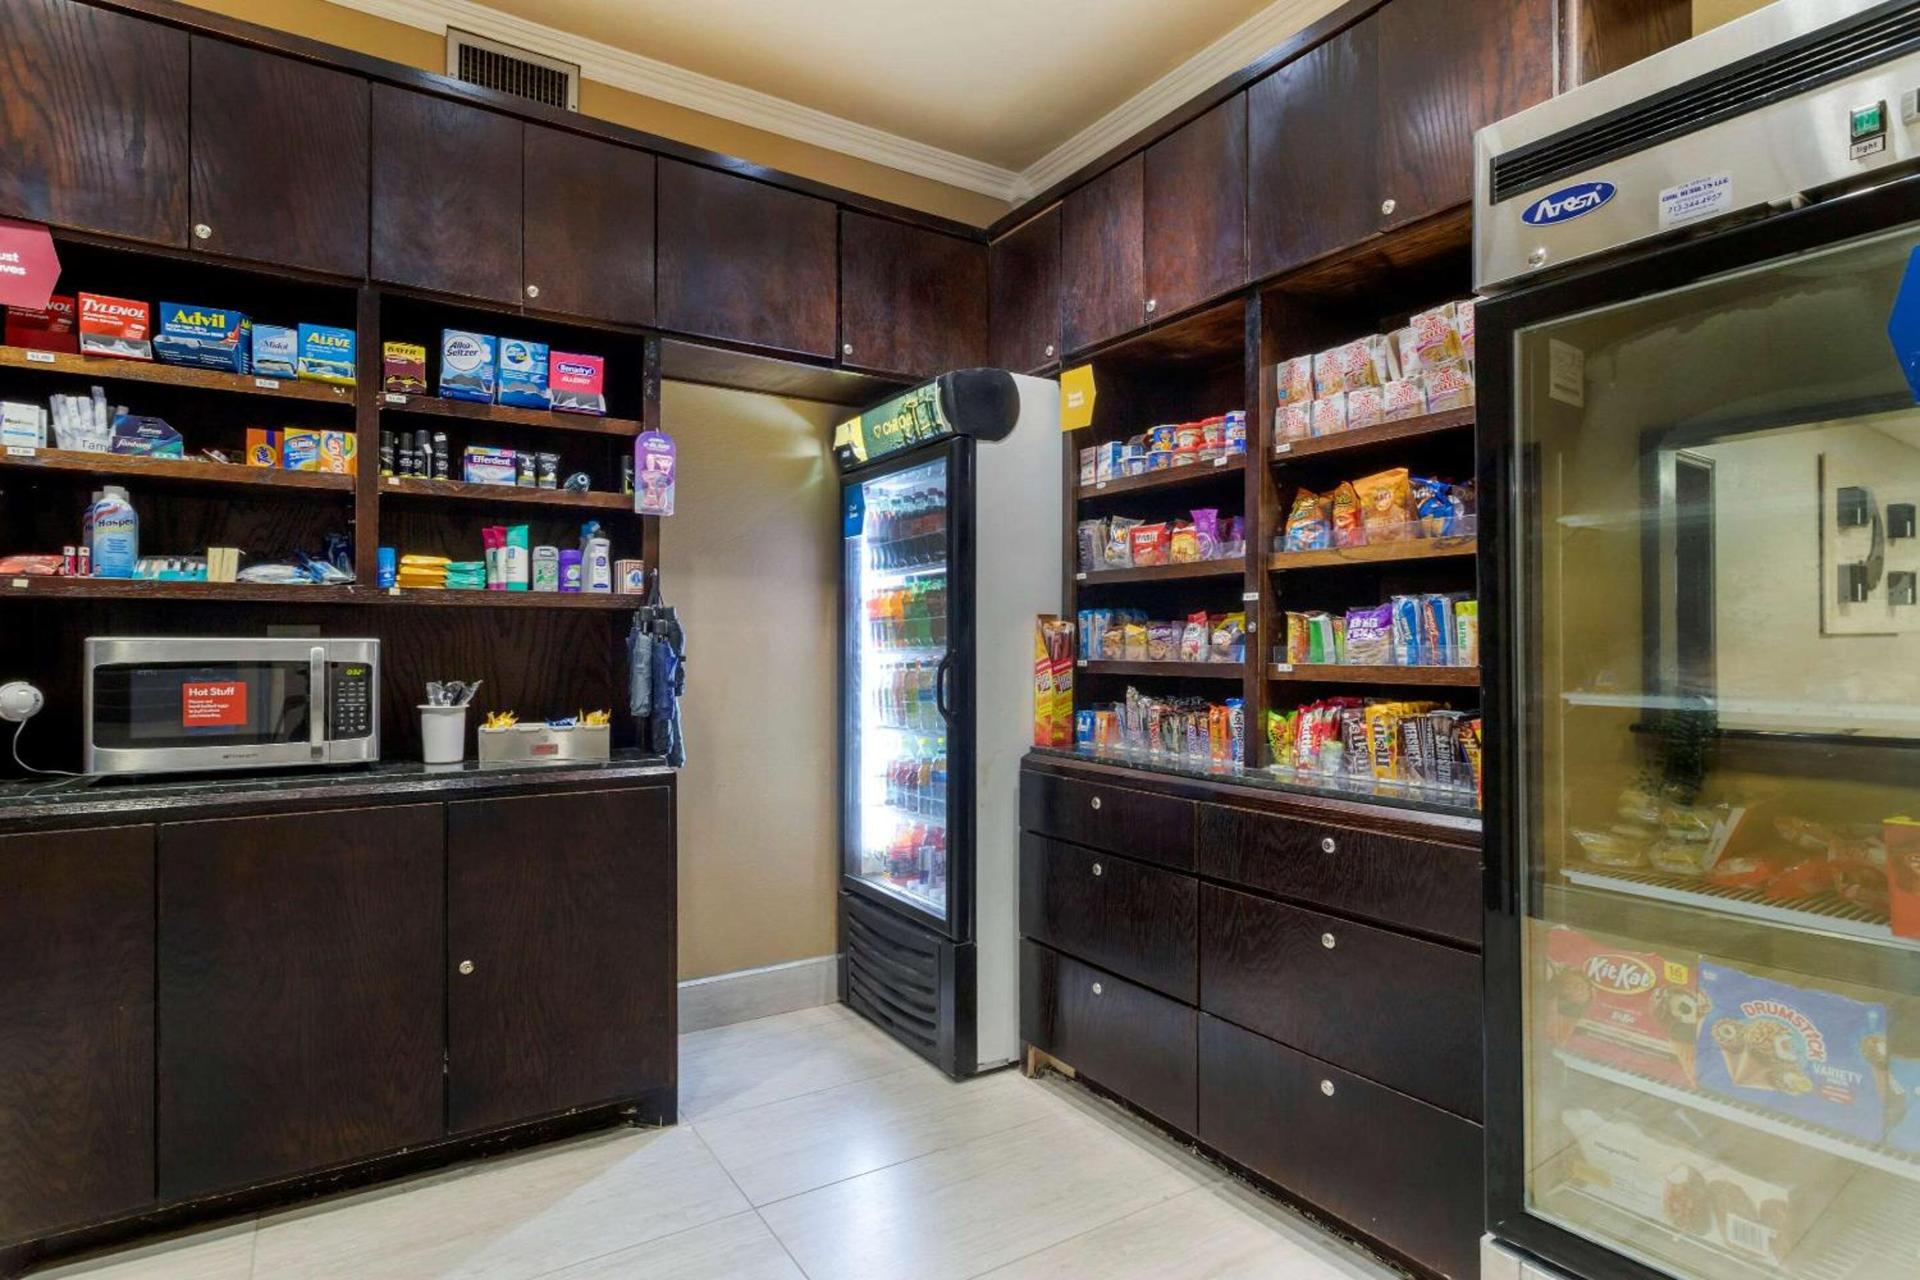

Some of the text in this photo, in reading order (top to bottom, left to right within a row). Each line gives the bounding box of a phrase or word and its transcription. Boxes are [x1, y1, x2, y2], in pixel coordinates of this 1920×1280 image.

[1856, 142, 1877, 152] light
[82, 298, 146, 318] TYLENOL
[172, 310, 225, 328] Advil
[451, 341, 473, 349] Alka-
[560, 364, 593, 375] Benadryl
[473, 455, 511, 465] Efferdent
[189, 687, 235, 696] Hot Stuff
[1669, 965, 1685, 979] 16
[1741, 1000, 1826, 1062] DRUMSTICK
[1813, 1063, 1862, 1084] VARIETY
